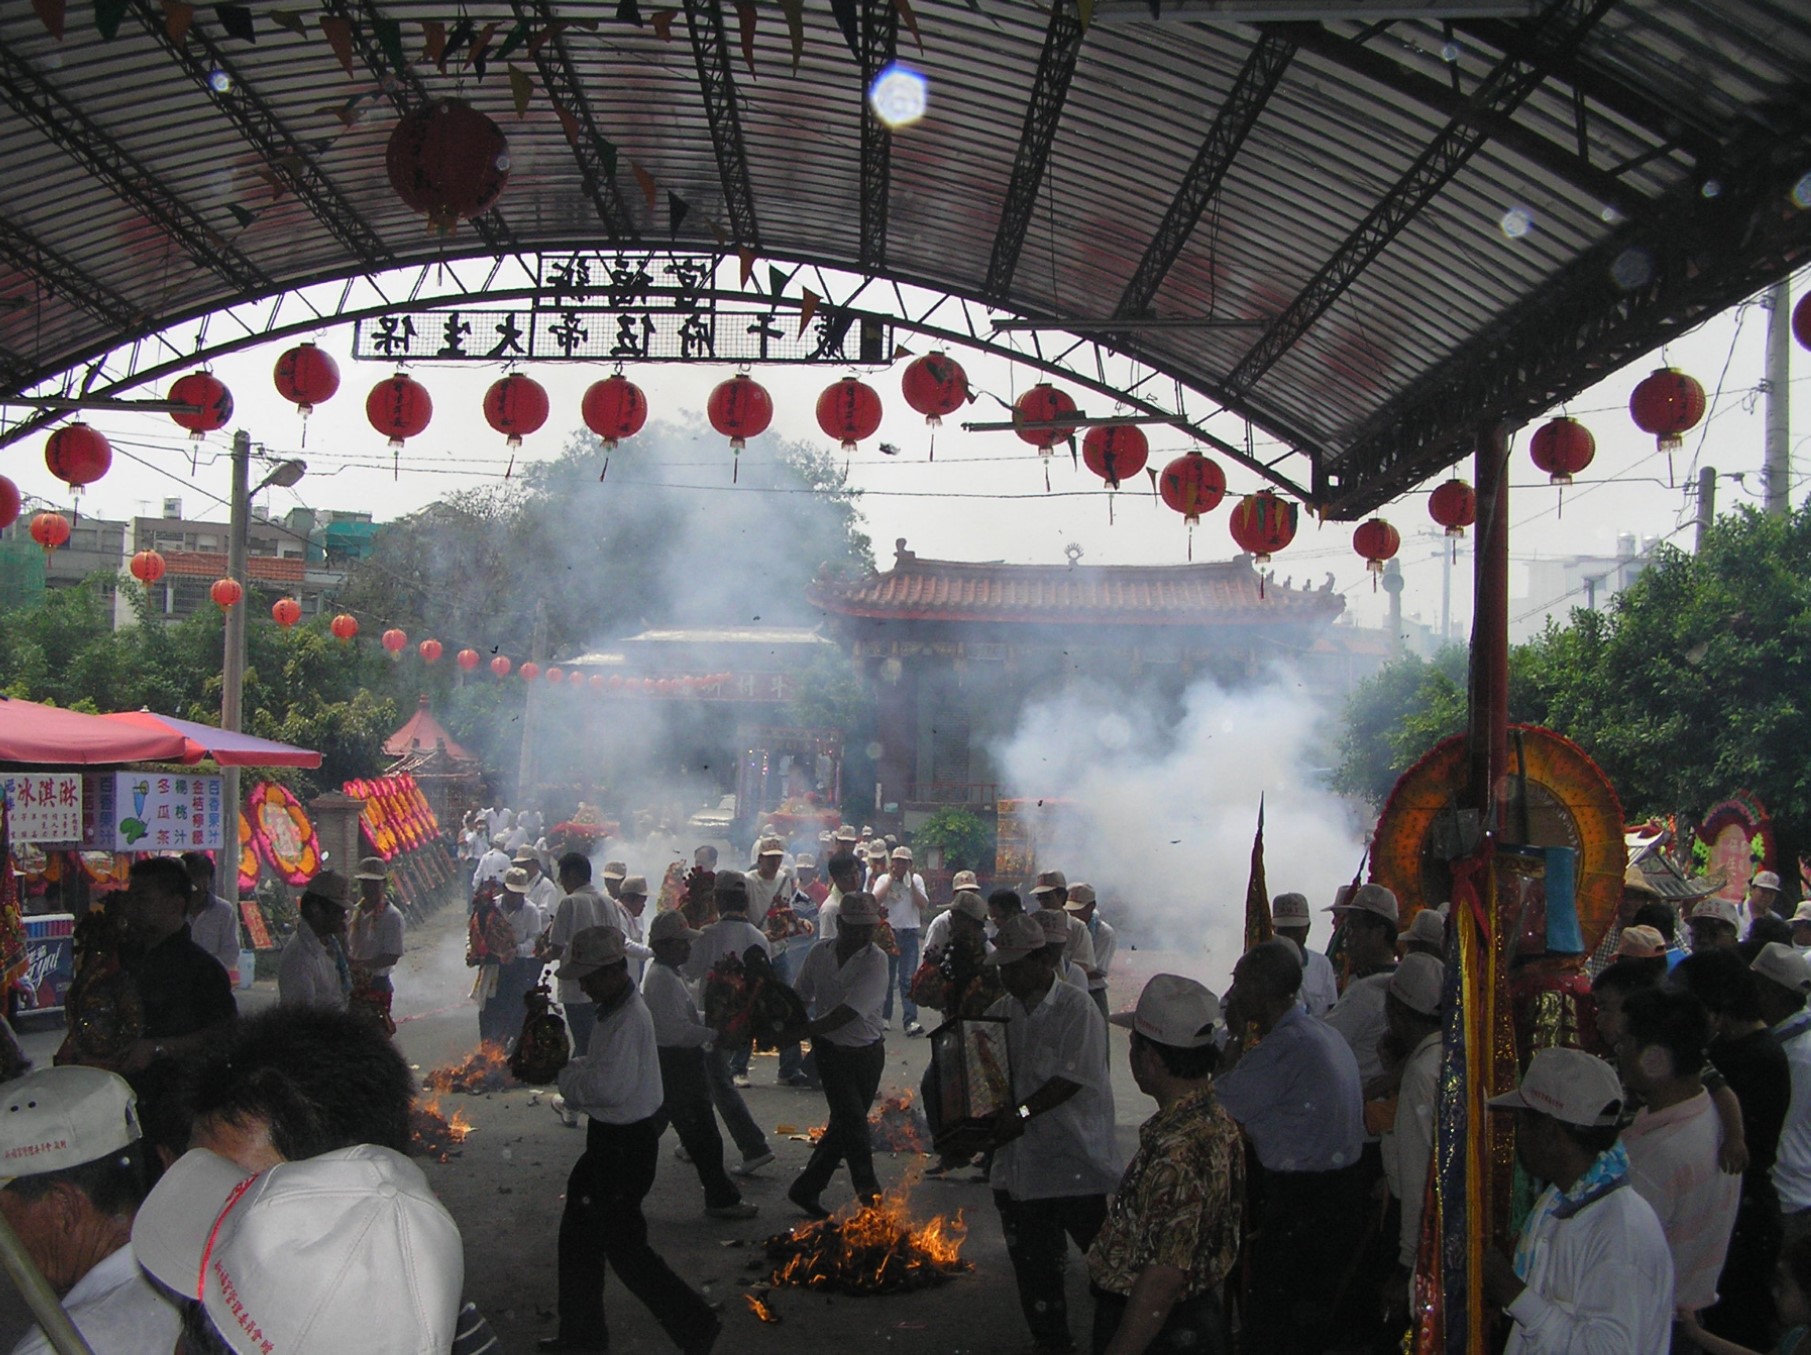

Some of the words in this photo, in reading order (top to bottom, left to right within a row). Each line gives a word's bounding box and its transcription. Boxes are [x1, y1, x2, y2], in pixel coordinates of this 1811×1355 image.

[18, 777, 78, 808] 冰淇淋
[101, 777, 115, 844] 百香果汁
[157, 779, 170, 845] 冬瓜茶
[174, 779, 188, 845] 楊桃汁
[192, 779, 204, 845] 金桔檸檬
[209, 779, 220, 845] 百香果汁
